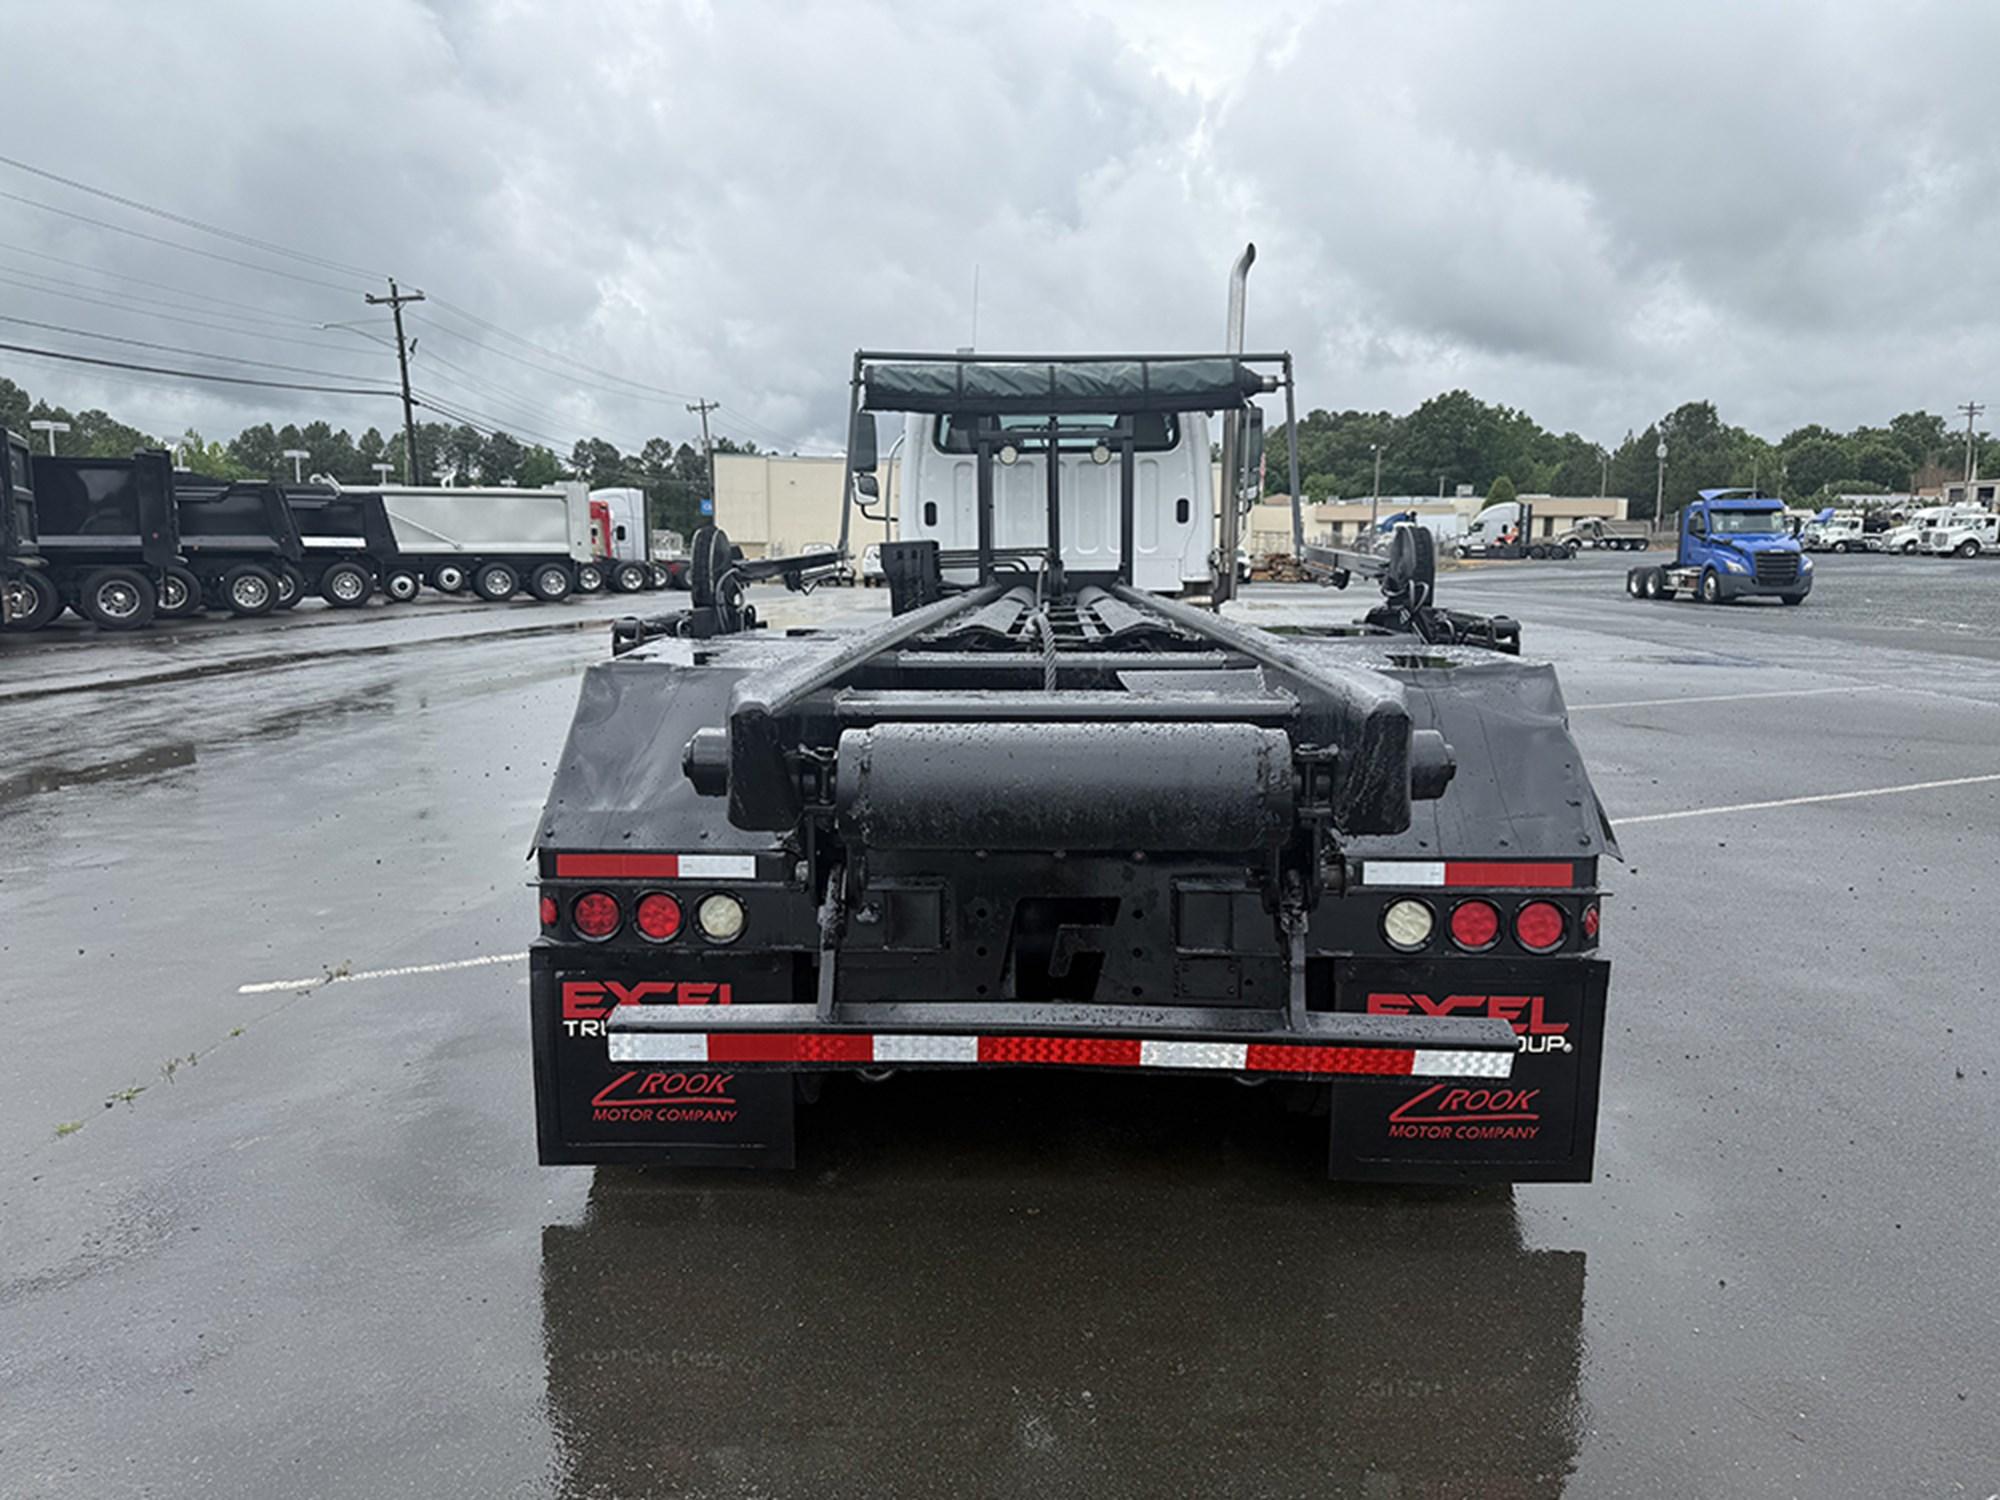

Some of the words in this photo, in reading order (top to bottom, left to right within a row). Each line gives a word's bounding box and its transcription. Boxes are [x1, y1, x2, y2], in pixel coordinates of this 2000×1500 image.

[592, 1109, 653, 1121] MOTOR
[656, 1109, 738, 1122] COMPANY
[1388, 1125, 1450, 1138] MOTOR
[1455, 1126, 1540, 1139] COMPANY
